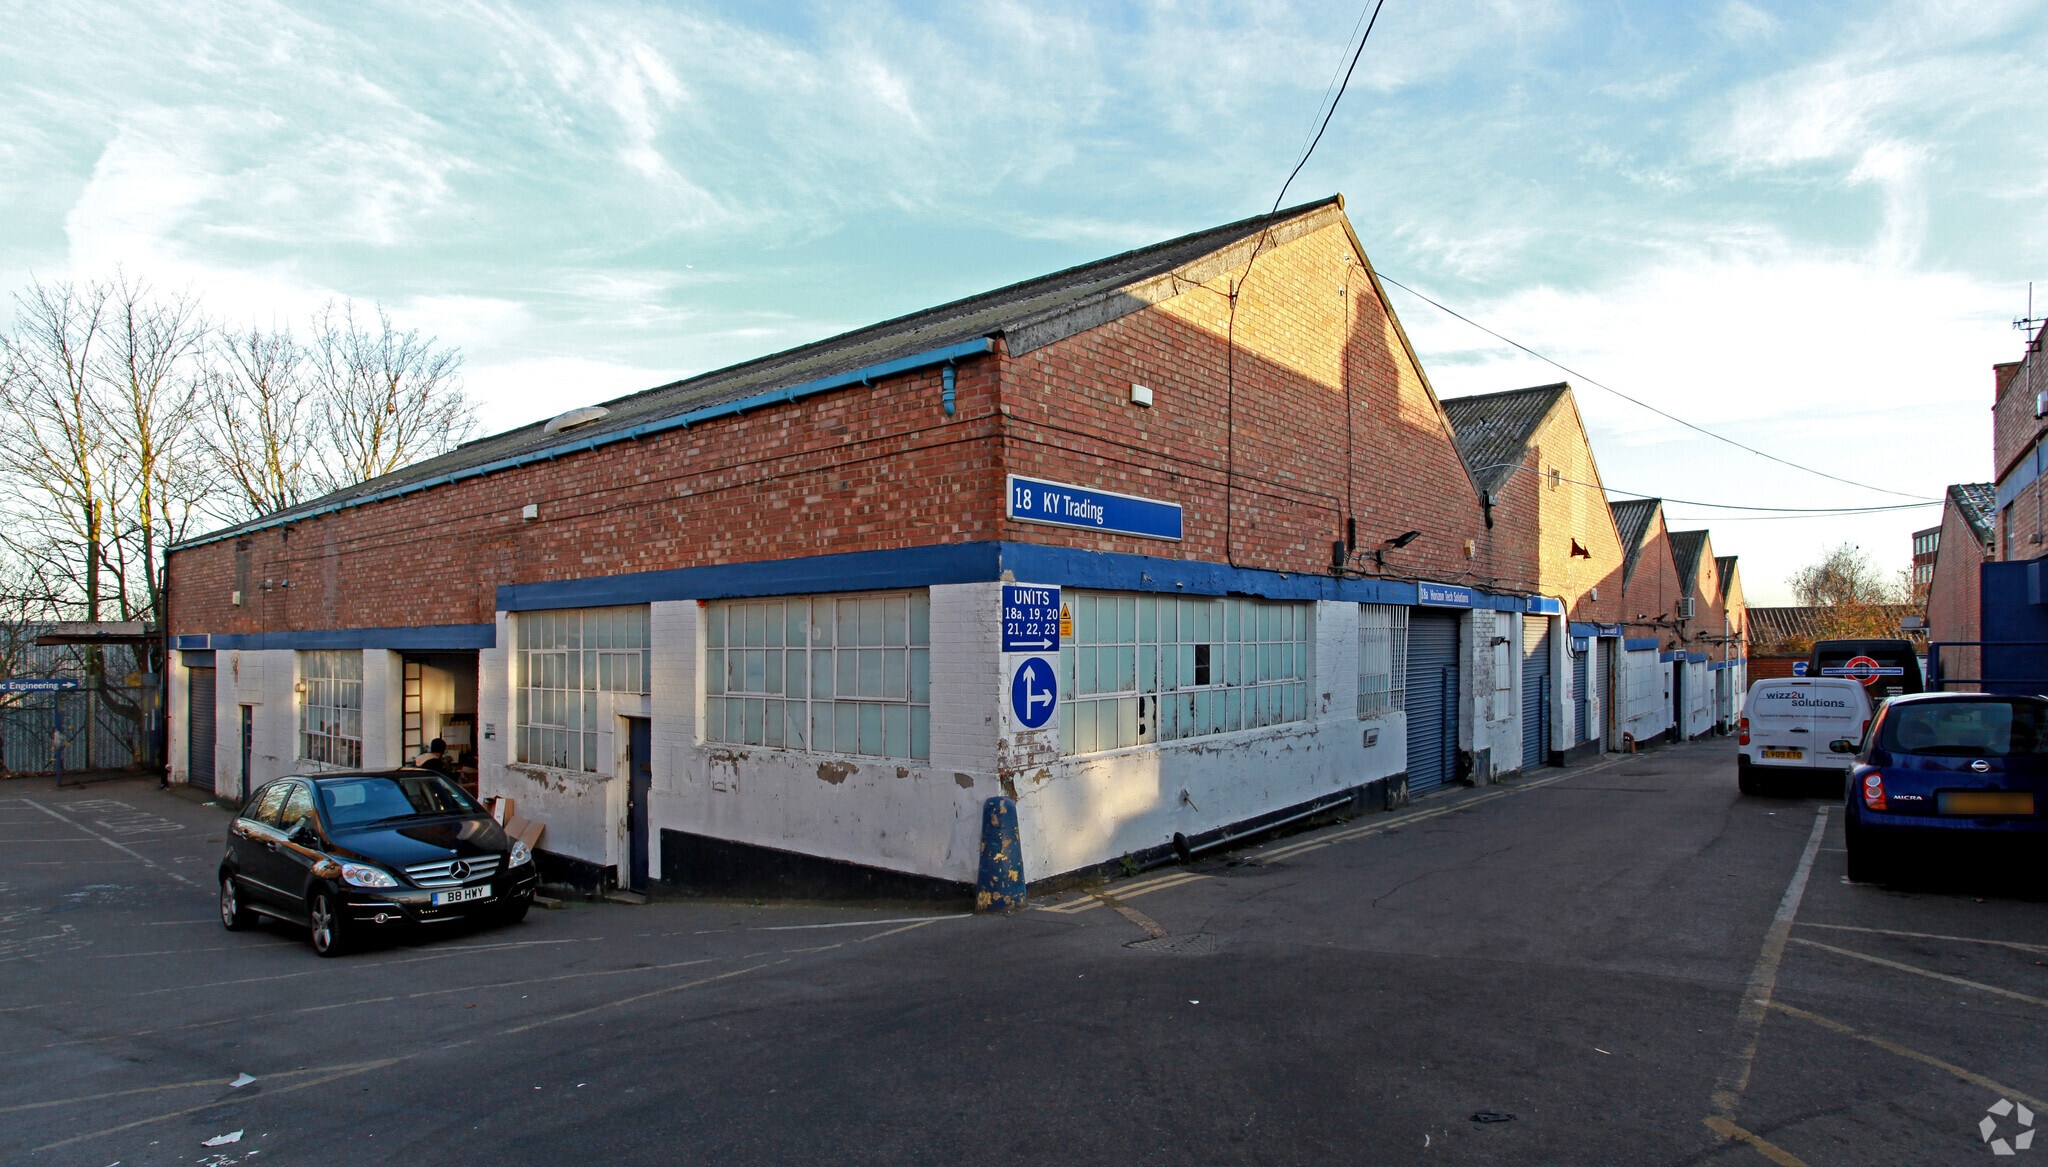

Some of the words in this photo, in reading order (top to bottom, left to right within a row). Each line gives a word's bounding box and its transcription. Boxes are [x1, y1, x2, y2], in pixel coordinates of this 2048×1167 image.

[1015, 487, 1032, 510] 18
[1043, 491, 1060, 514] KY
[1063, 495, 1104, 525] Trading
[1014, 589, 1050, 605] UNITS
[1430, 589, 1445, 601] Horizon
[1445, 590, 1453, 602] Tech
[1454, 592, 1469, 603] Solutions
[1005, 607, 1025, 621] 18a,
[1029, 608, 1043, 622] 19,
[1046, 608, 1058, 620] 20
[1007, 622, 1023, 637] 21,
[1026, 623, 1041, 637] 22,
[1044, 623, 1056, 635] 23
[9, 681, 59, 691] Engineering
[1766, 691, 1805, 700] wizz2u
[1791, 698, 1845, 708] solutions
[447, 891, 462, 902] B8
[464, 887, 483, 899] HWY
